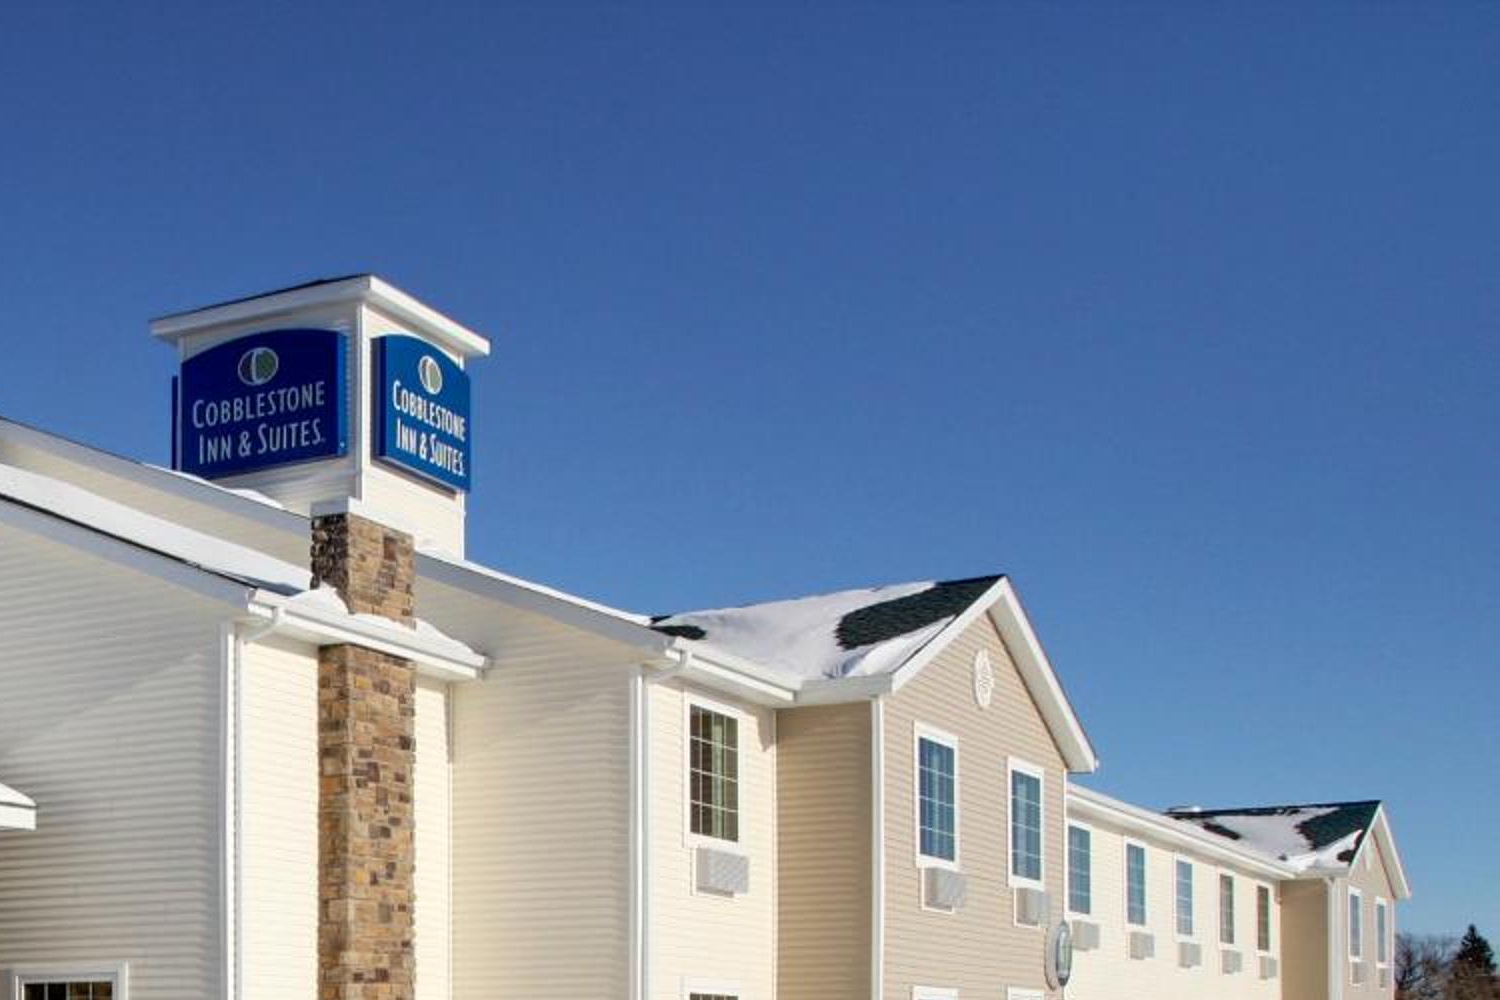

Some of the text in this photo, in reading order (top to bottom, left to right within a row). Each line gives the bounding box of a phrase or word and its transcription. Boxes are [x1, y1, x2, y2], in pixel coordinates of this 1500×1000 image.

[192, 381, 325, 429] COBBLESTONE
[393, 380, 466, 442] COBBLESTONE
[198, 419, 322, 465] INN & SUITES
[396, 419, 465, 476] INN & SUITES
